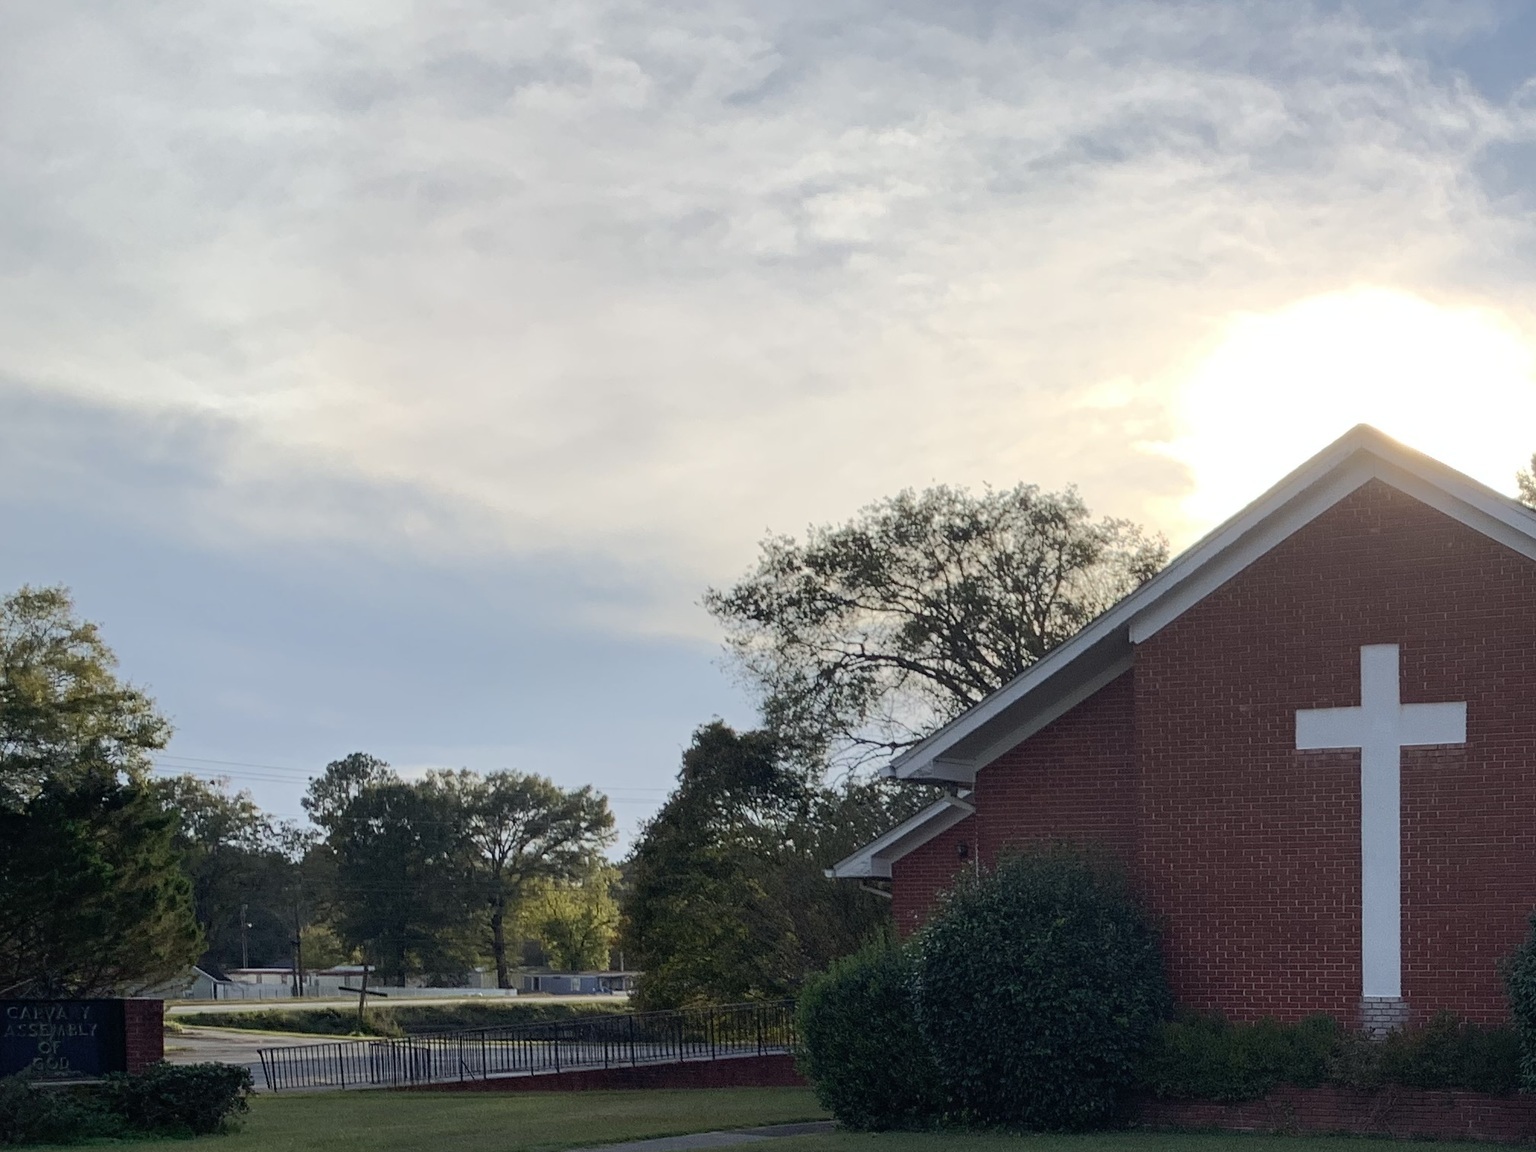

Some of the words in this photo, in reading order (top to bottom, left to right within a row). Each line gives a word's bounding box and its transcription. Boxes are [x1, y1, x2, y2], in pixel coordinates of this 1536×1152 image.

[6, 1006, 90, 1020] CALVAY
[4, 1023, 97, 1037] ASSEMBLY
[38, 1041, 61, 1054] OF
[33, 1056, 69, 1070] GOD
